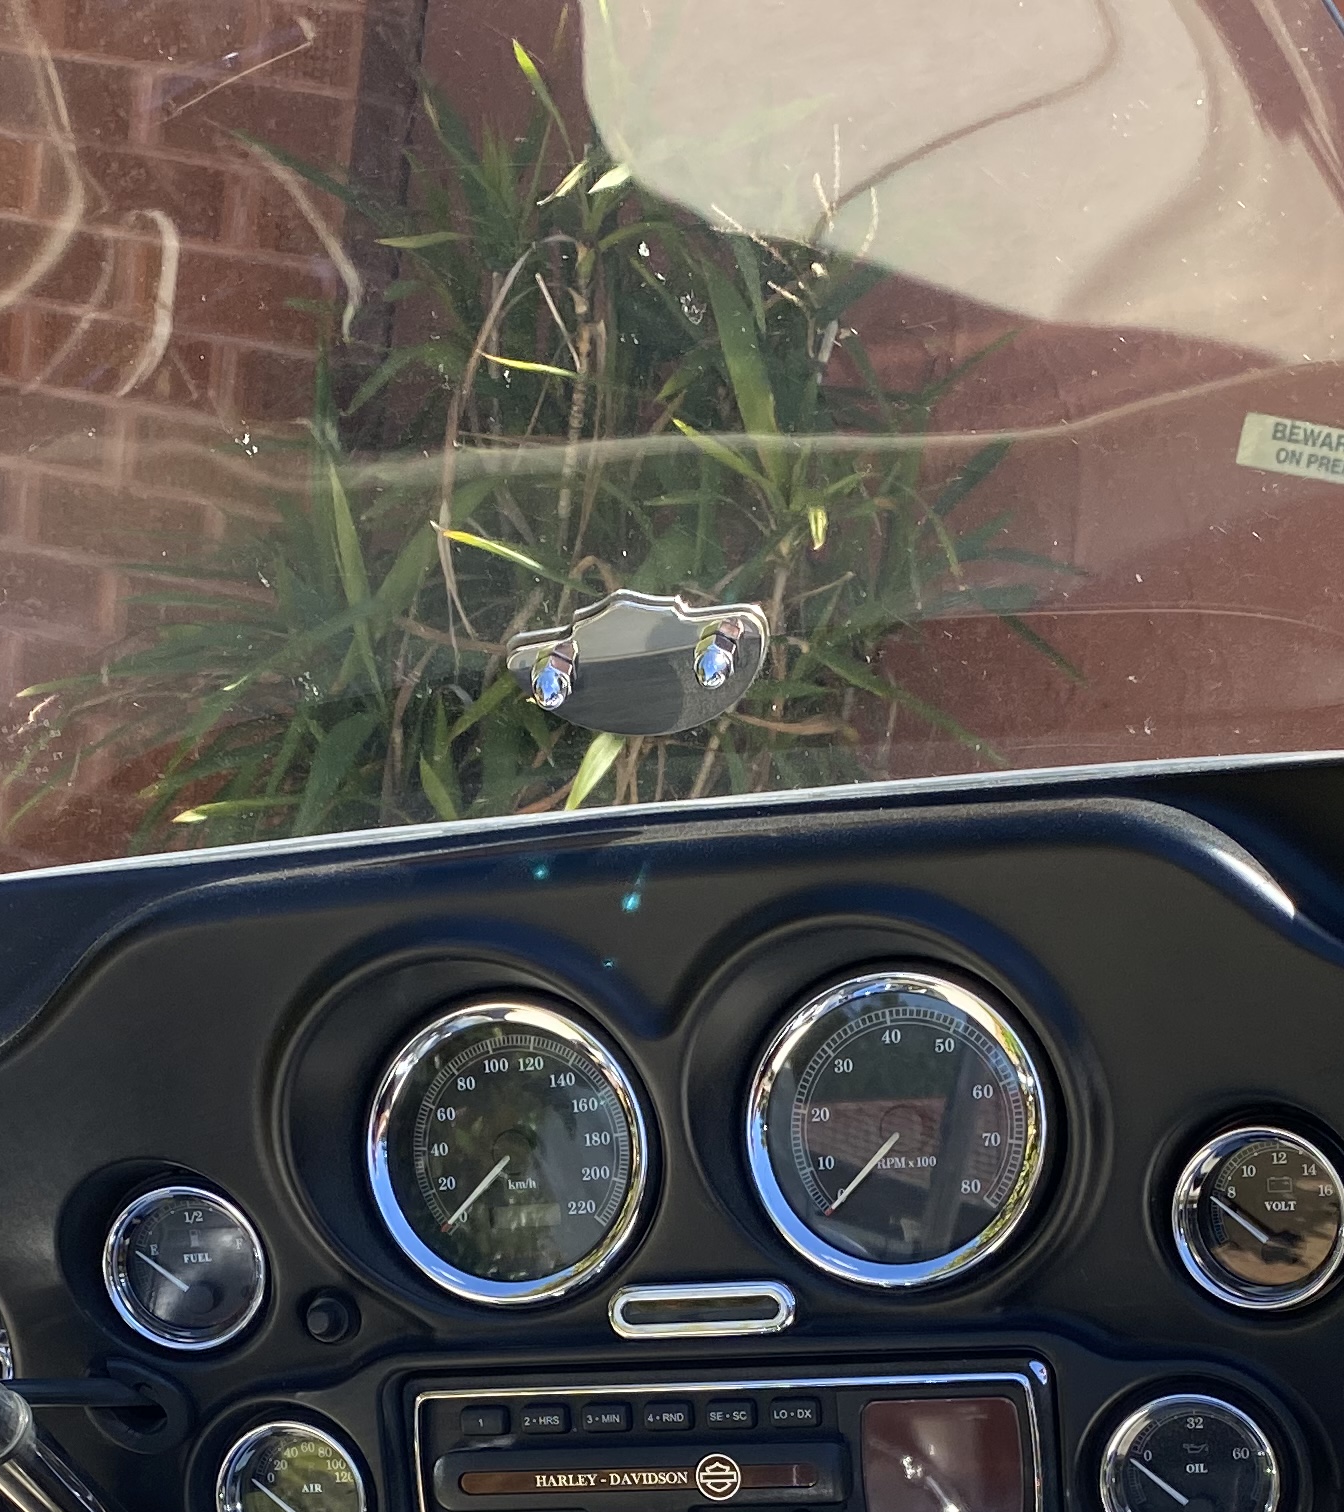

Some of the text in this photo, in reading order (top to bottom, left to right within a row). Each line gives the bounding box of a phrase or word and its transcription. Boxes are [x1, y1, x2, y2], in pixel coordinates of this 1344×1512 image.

[1275, 447, 1304, 466] ON
[881, 1029, 901, 1044] 40
[934, 1038, 955, 1053] 50
[483, 1058, 509, 1073] 100
[518, 1056, 544, 1071] 120
[834, 1058, 854, 1074] 30
[457, 1076, 476, 1091] 80
[549, 1072, 576, 1088] 140
[972, 1084, 994, 1099] 60
[572, 1097, 598, 1113] 160
[437, 1107, 456, 1122] 60
[811, 1107, 830, 1122] 20
[584, 1132, 611, 1146] 180
[982, 1132, 1001, 1147] 70
[431, 1142, 449, 1157] 40
[818, 1156, 835, 1170] 10
[877, 1157, 906, 1170] RPM
[916, 1155, 937, 1168] 100
[1271, 1152, 1288, 1165] 12
[581, 1166, 610, 1181] 200
[1241, 1165, 1256, 1178] 10
[1301, 1163, 1317, 1176] 14
[438, 1176, 456, 1191] 20
[508, 1178, 537, 1190] km/h
[961, 1179, 981, 1194] 80
[1227, 1186, 1236, 1198] 8
[1318, 1184, 1334, 1197] 16
[567, 1200, 596, 1215] 220
[1264, 1201, 1297, 1212] VOLT
[183, 1211, 204, 1225] 1/2
[150, 1244, 159, 1256] E
[235, 1238, 243, 1250] F
[183, 1252, 212, 1264] FUEL
[478, 1418, 484, 1427] 1
[1186, 1417, 1204, 1429] 32
[283, 1447, 299, 1458] 40
[300, 1442, 316, 1453] 60
[317, 1446, 333, 1458] 80
[1232, 1447, 1250, 1460] 60
[1143, 1450, 1152, 1462] 0
[273, 1459, 288, 1471] 20
[326, 1459, 346, 1470] 100
[1186, 1463, 1208, 1474] OIL
[267, 1472, 275, 1483] 0
[334, 1471, 354, 1483] 120
[535, 1472, 598, 1488] HARLEY
[609, 1471, 689, 1487] DAVIDSON
[301, 1483, 323, 1494] AIR
